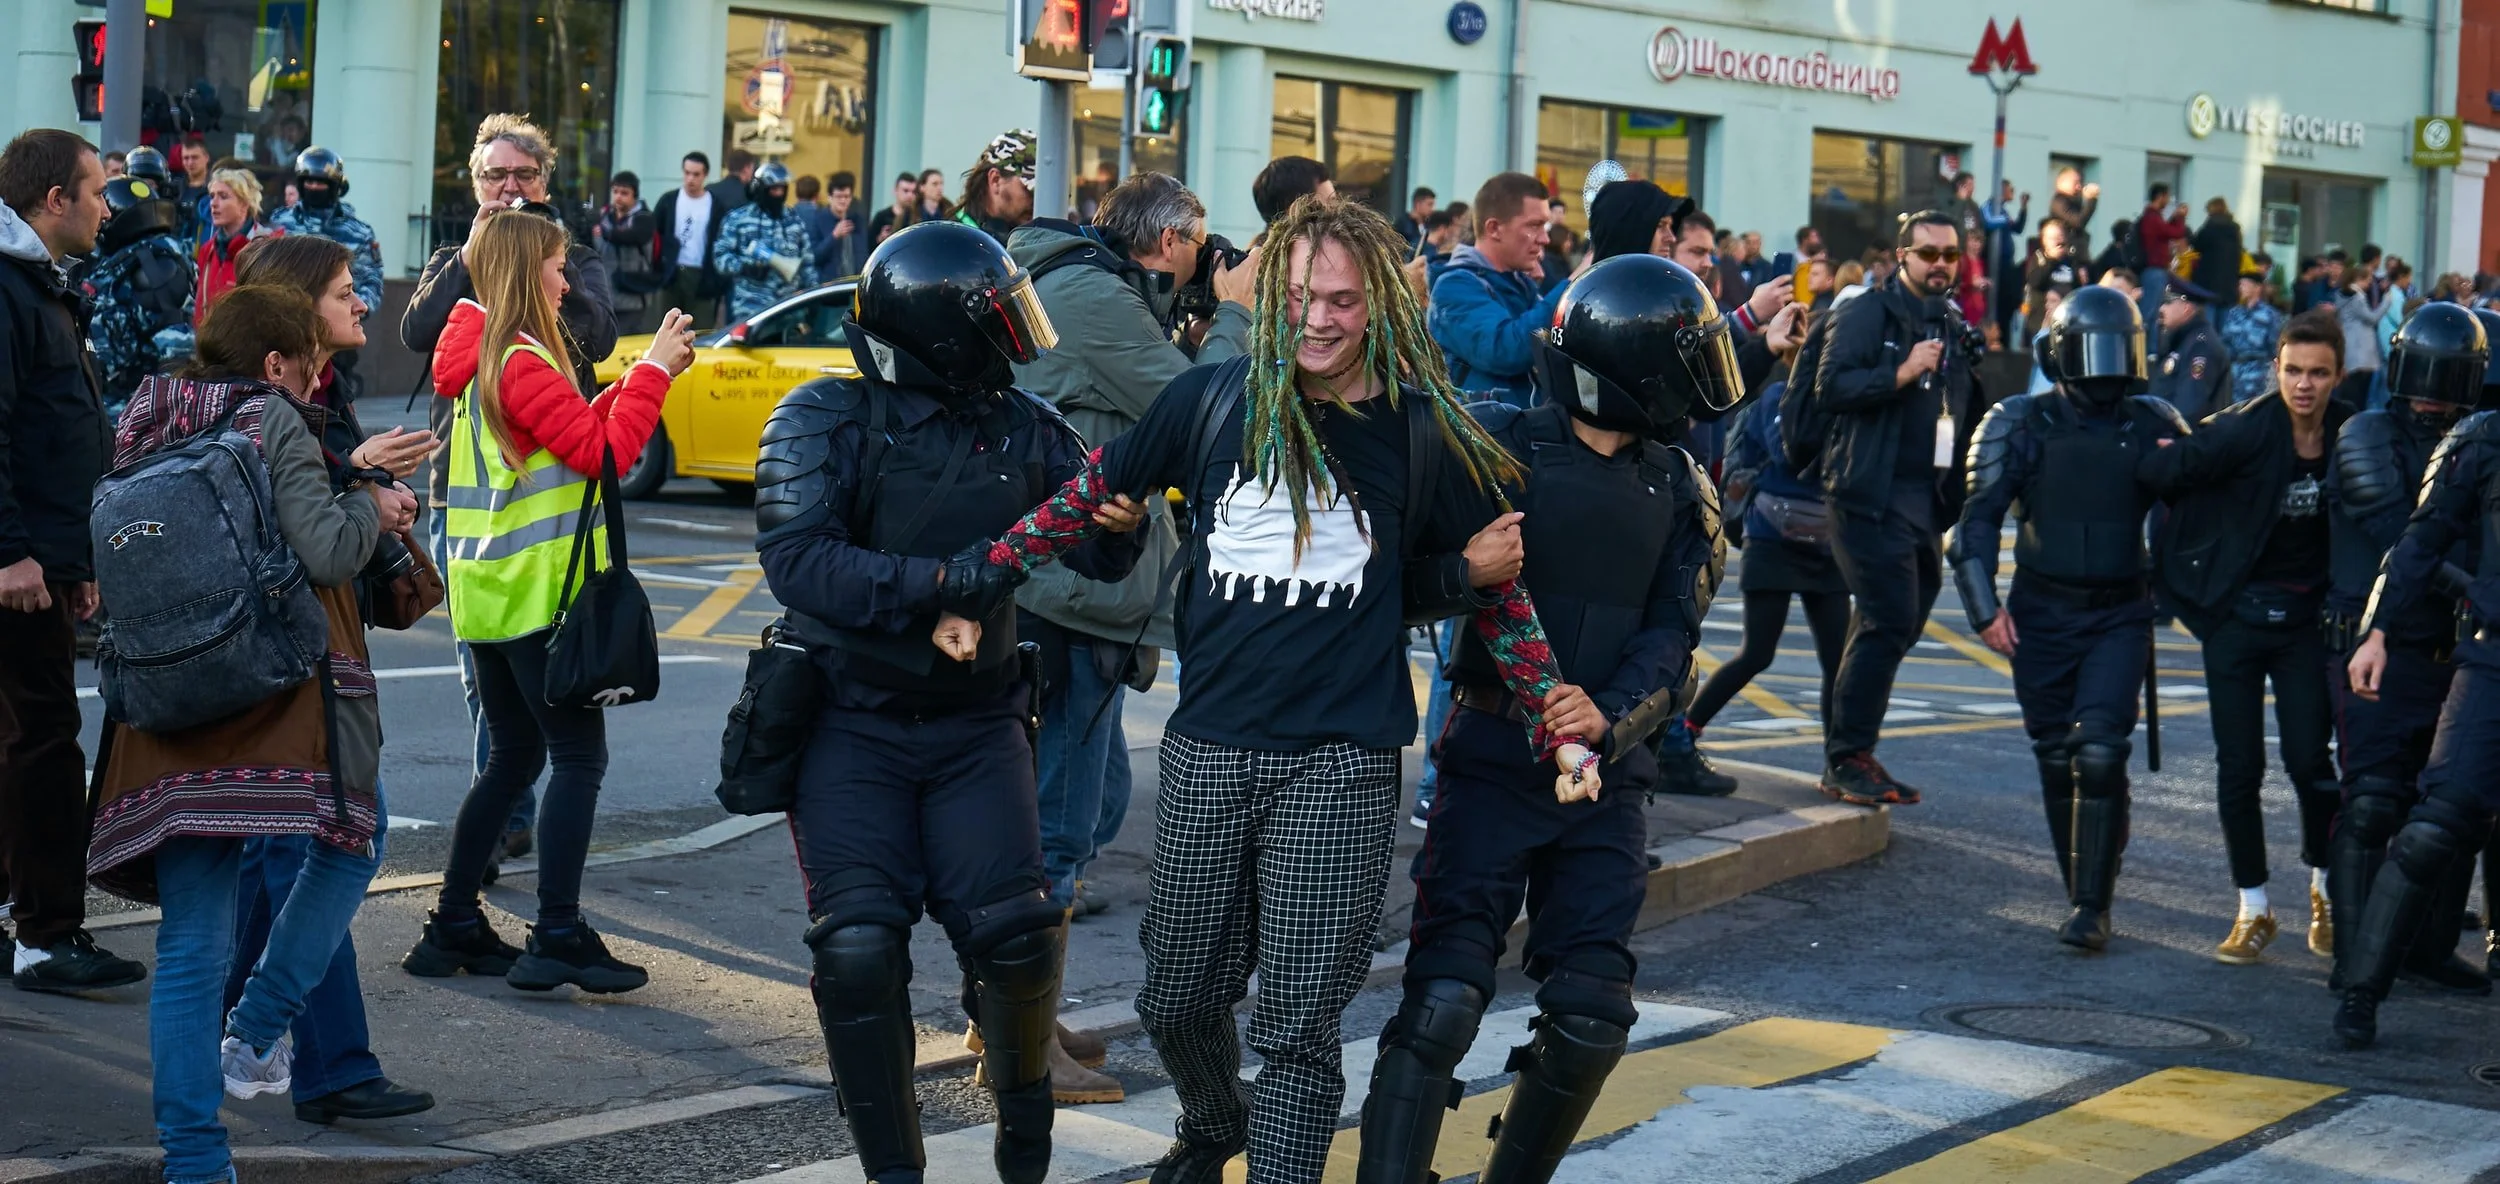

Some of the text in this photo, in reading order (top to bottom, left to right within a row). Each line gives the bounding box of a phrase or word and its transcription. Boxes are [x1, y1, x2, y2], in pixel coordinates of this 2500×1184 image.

[1688, 38, 1899, 99] Шоколадница
[2218, 104, 2364, 145] YVES ROCHER
[713, 361, 761, 381] Яндекс
